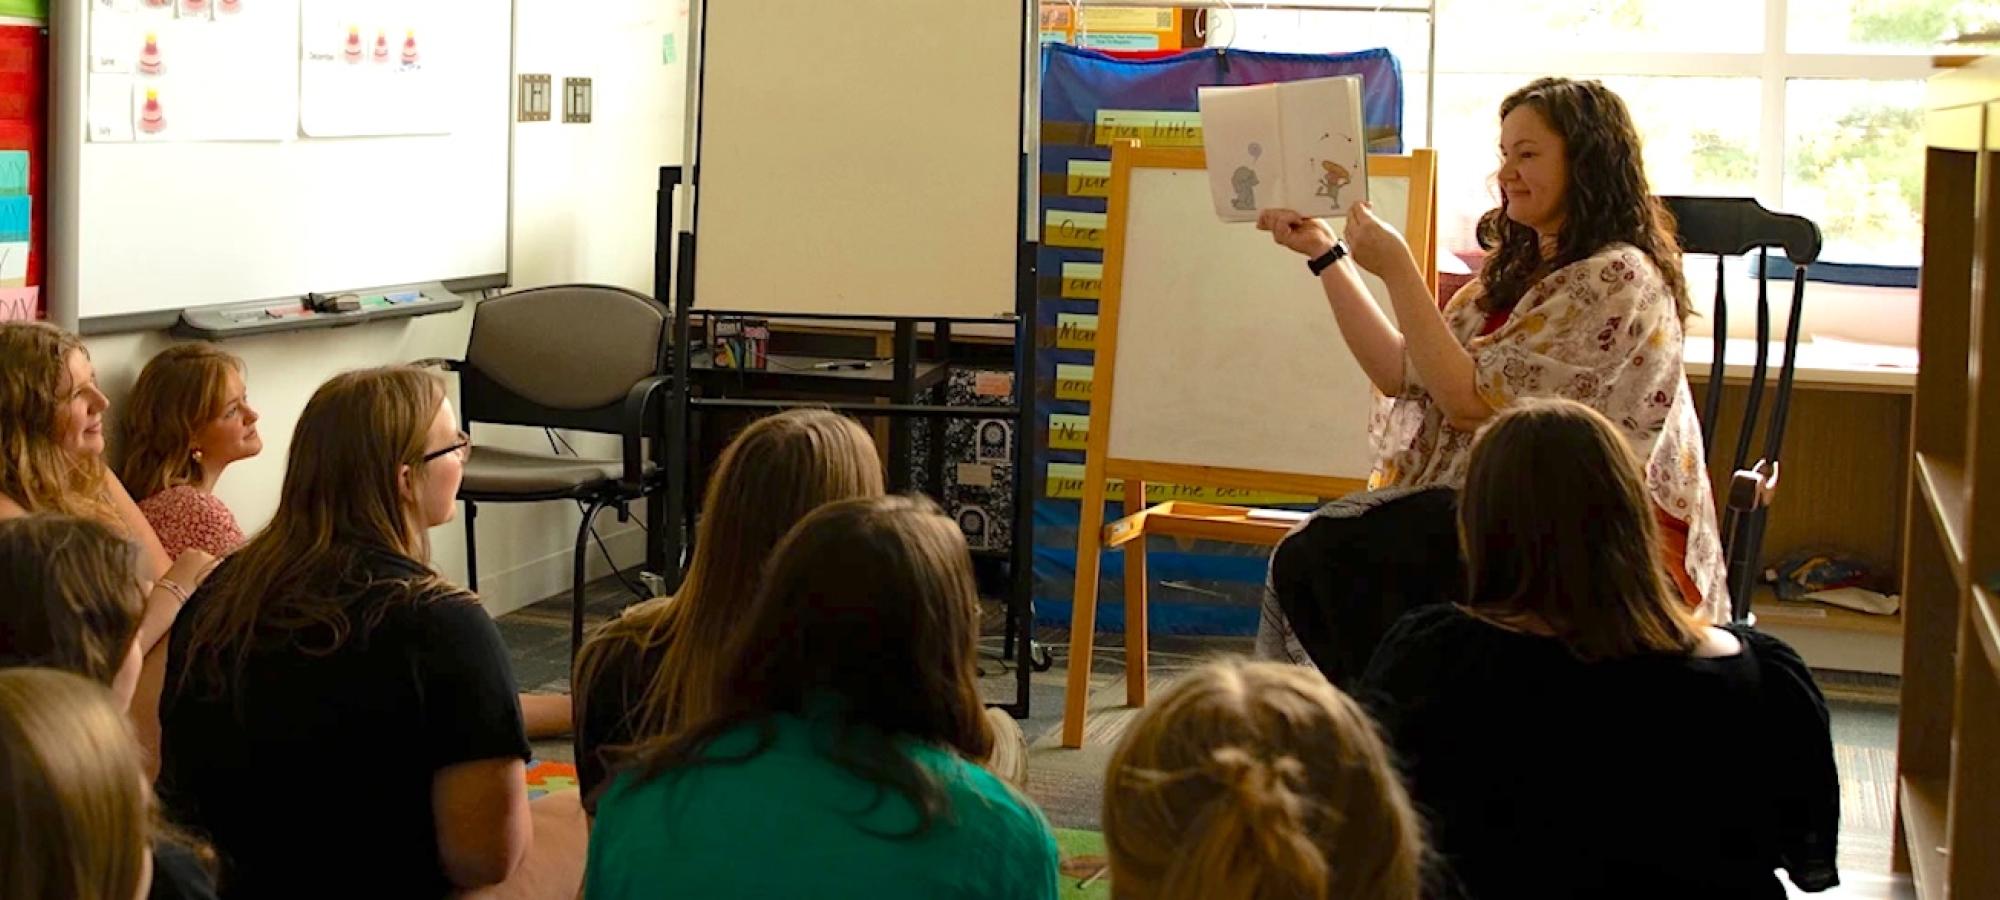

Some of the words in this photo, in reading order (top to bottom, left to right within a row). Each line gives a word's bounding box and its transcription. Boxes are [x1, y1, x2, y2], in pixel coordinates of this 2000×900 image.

[1103, 117, 1140, 138] Five
[1152, 120, 1196, 138] little
[1060, 219, 1098, 240] One
[1171, 483, 1204, 497] the
